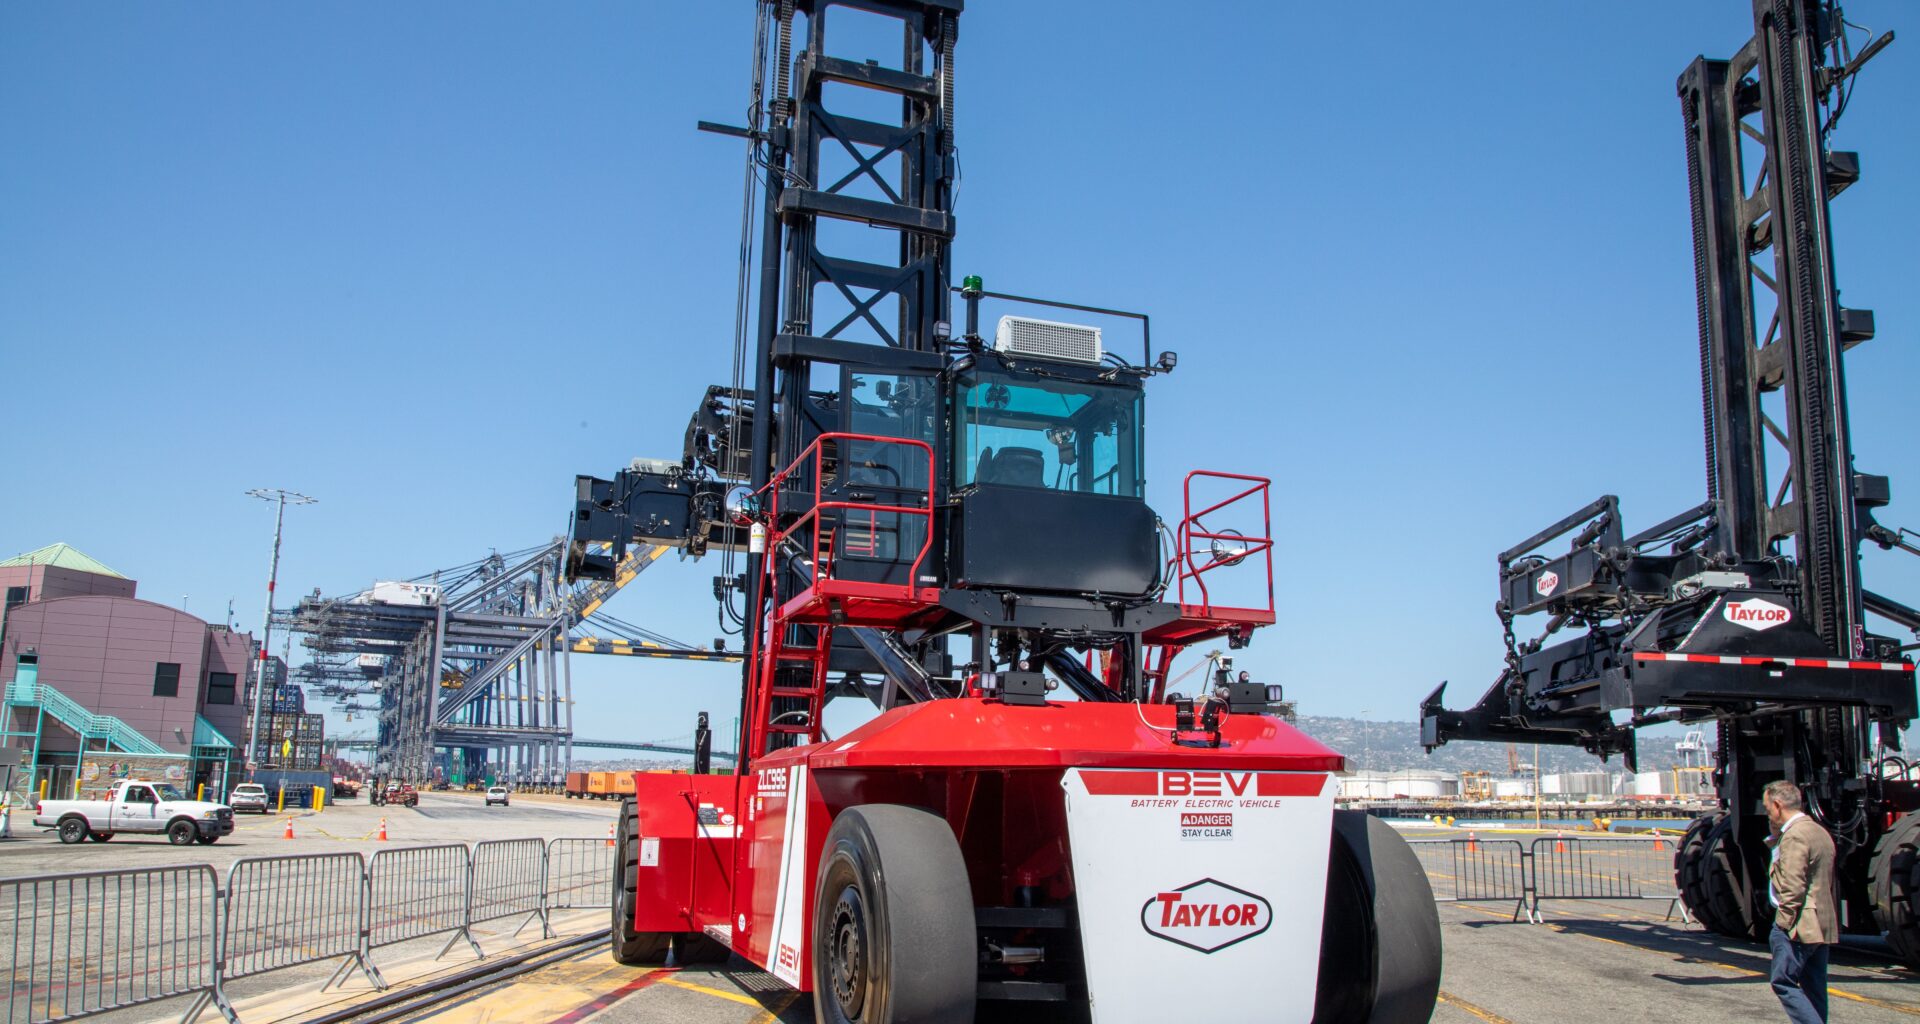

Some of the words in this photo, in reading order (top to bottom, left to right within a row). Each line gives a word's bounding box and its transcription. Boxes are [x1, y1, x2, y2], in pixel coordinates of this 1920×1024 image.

[414, 585, 436, 593] YTI
[1538, 576, 1557, 592] TAYLOR
[1727, 603, 1786, 621] TAYLOR
[757, 768, 787, 790] ZLC996
[1163, 772, 1253, 796] BEV
[1130, 799, 1179, 808] BATTERY
[1185, 799, 1234, 808] ELECTRIC
[1239, 799, 1281, 808] VEHICLE
[1191, 815, 1232, 825] DANGER
[1182, 828, 1203, 837] STAY
[1204, 828, 1232, 837] CLEAR
[1156, 892, 1259, 927] TAYLOR
[780, 943, 800, 971] BEV
